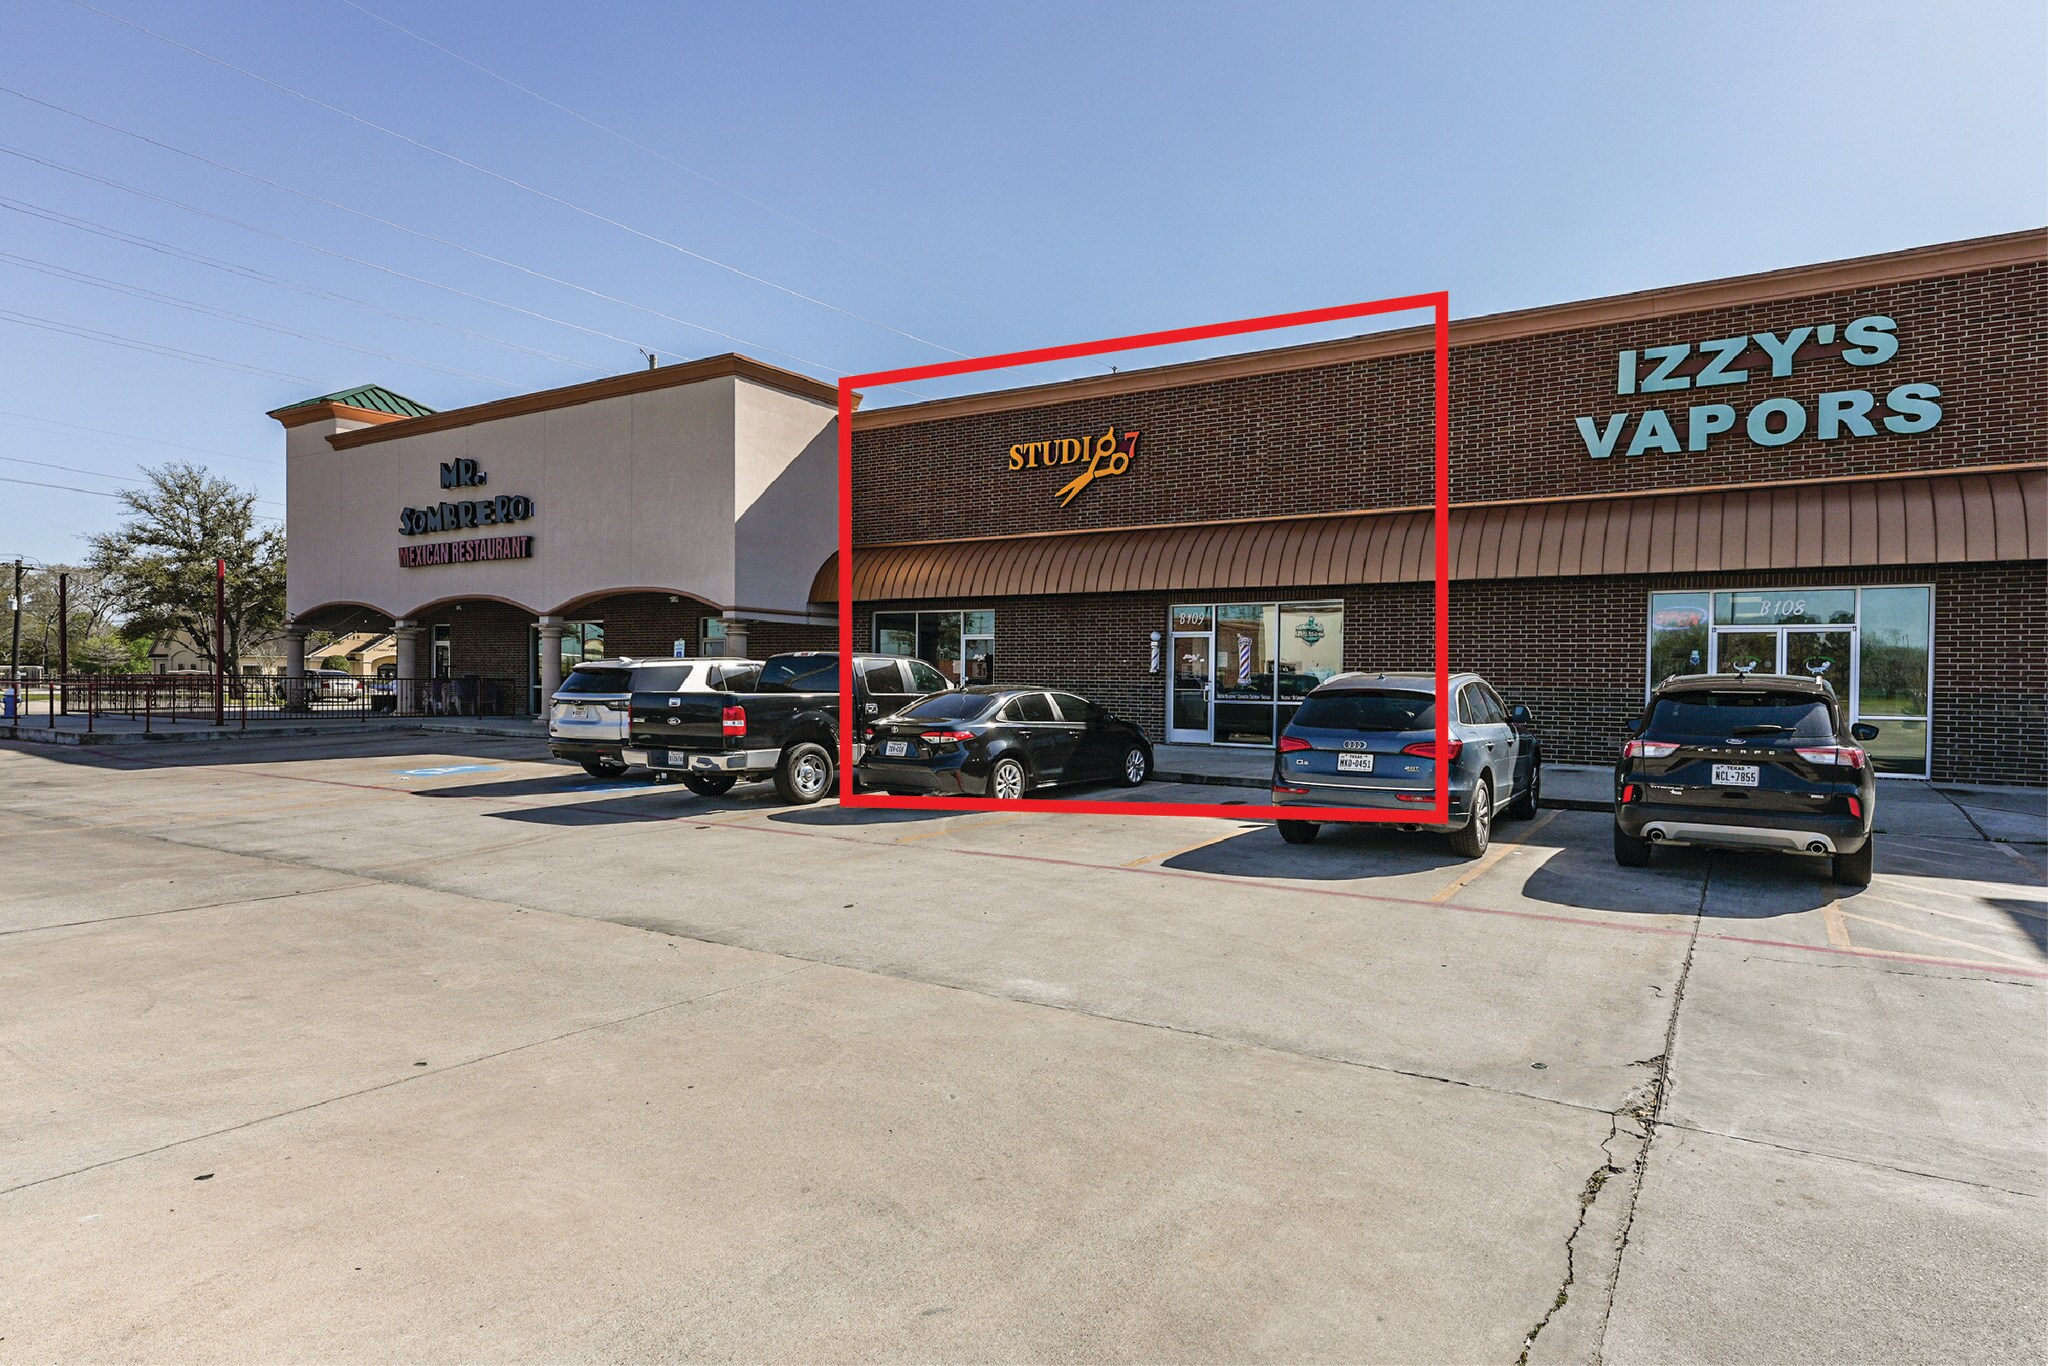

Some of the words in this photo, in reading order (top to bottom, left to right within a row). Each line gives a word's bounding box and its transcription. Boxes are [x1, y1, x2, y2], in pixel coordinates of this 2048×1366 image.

[1617, 315, 1900, 395] IZZY'S
[1574, 382, 1943, 459] VAPORS
[1124, 431, 1140, 459] 7
[440, 457, 487, 489] MR.
[398, 494, 534, 536] SOMBRERO
[398, 542, 449, 568] MEXICAN
[451, 535, 532, 564] RESTAURANT
[1178, 612, 1205, 626] B109
[1760, 599, 1806, 616] B108
